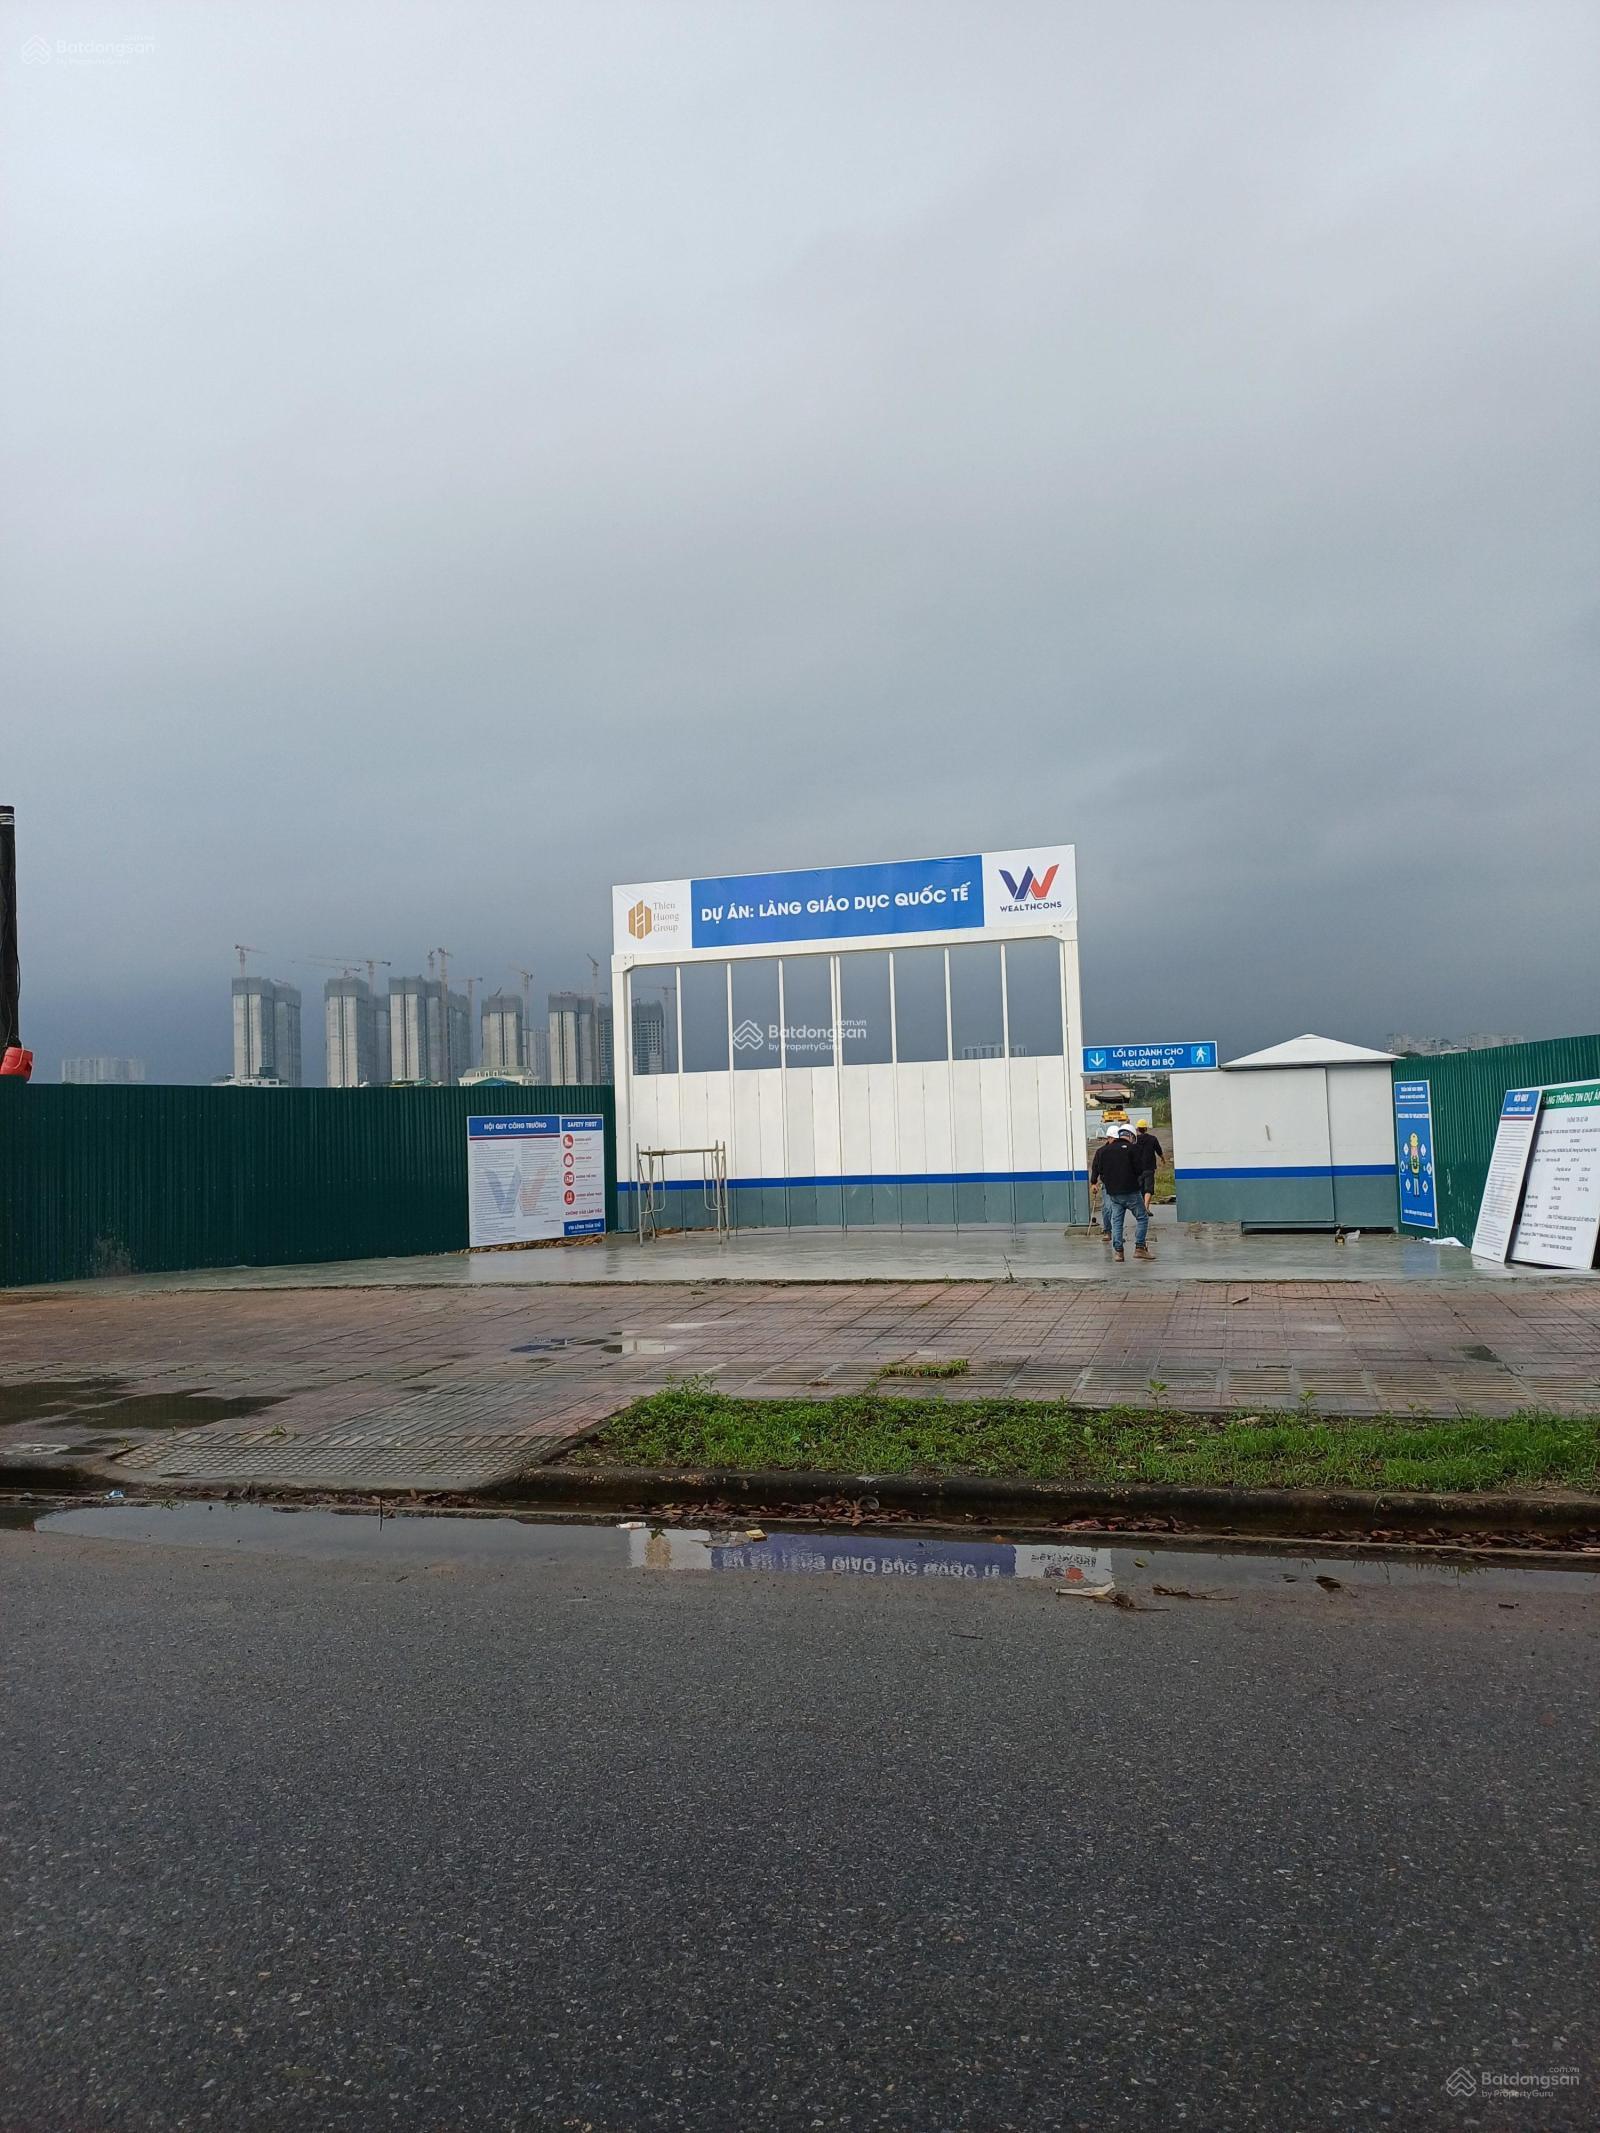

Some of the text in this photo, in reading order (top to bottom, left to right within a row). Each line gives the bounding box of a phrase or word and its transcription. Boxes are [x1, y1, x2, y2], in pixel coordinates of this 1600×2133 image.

[701, 881, 972, 924] DỰ ÁN: LÀNG GIÁO DỤC QUỐC TẾ
[1000, 901, 1062, 912] WEALTHCONS
[653, 924, 679, 933] Group
[1112, 1047, 1184, 1058] LỐI ĐI DÀNH CHO
[1122, 1057, 1175, 1068] NGƯỜI ĐI BỘ
